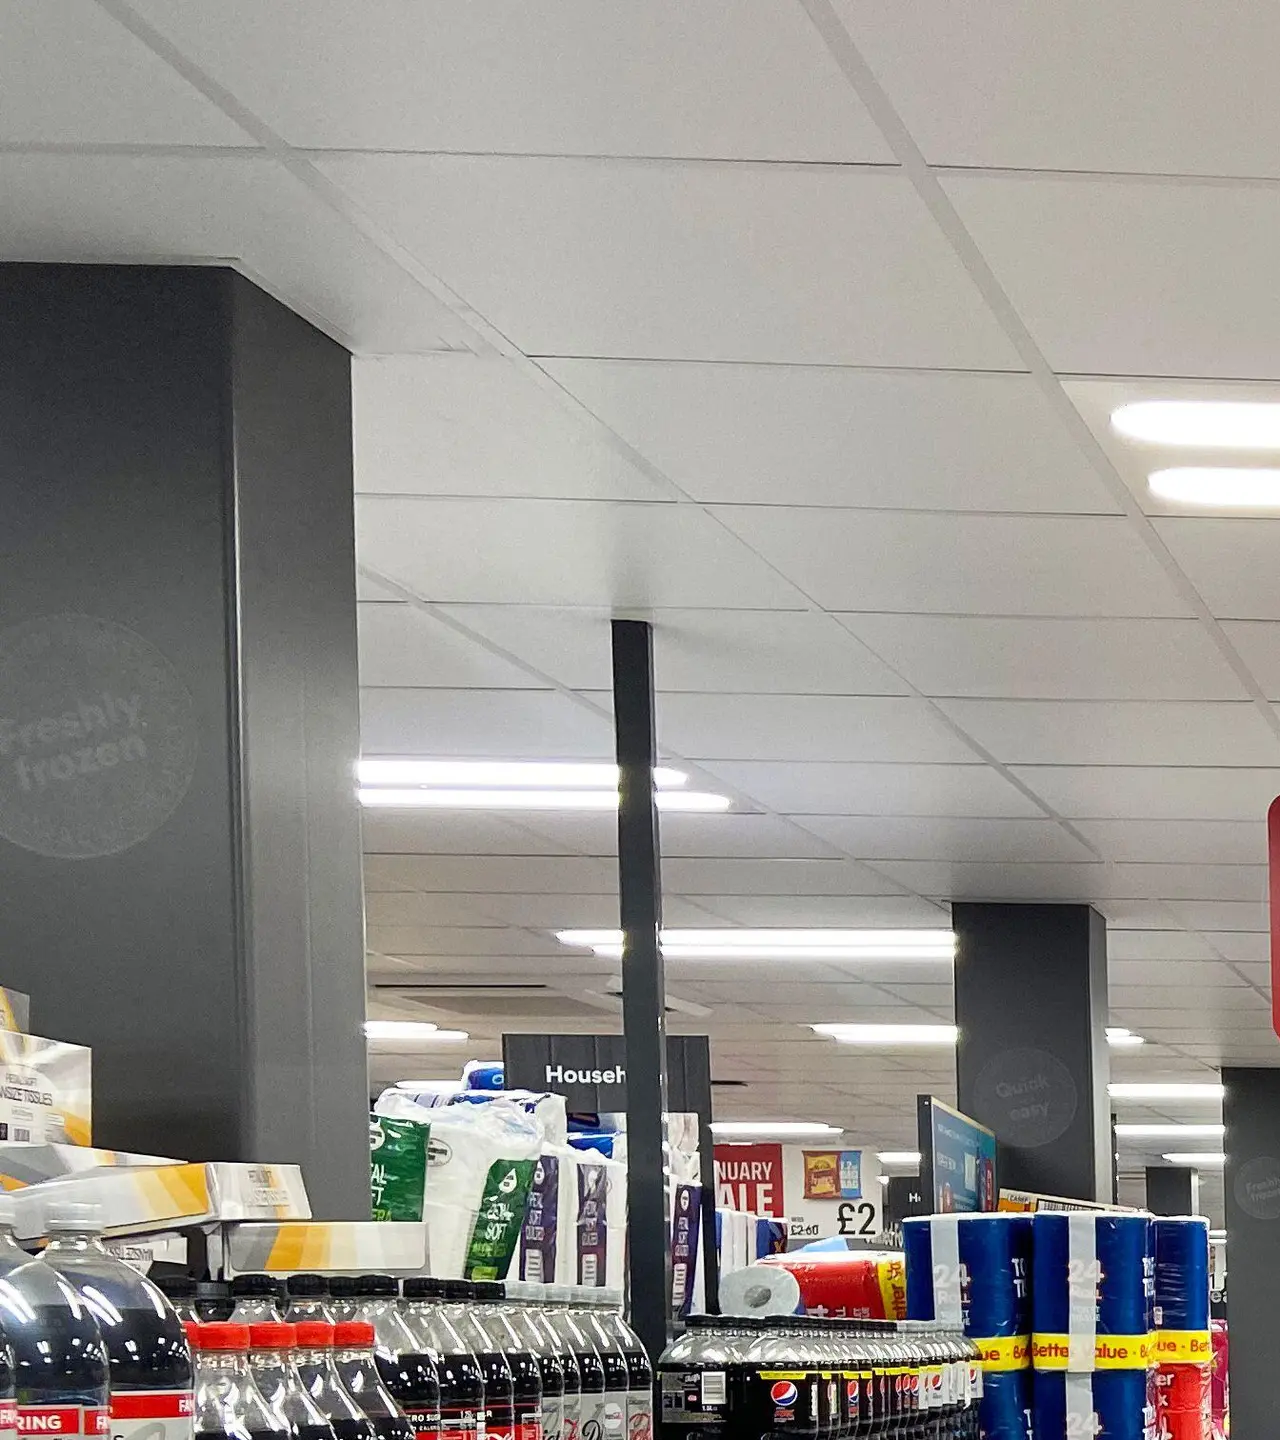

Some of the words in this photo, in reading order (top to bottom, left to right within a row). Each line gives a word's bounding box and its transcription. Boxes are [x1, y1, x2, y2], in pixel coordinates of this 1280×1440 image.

[545, 1064, 626, 1085] Househ
[714, 1161, 772, 1182] NUARY
[713, 1183, 775, 1217] ALE
[837, 1202, 876, 1235] £2
[1068, 1259, 1106, 1283] 24
[1067, 1411, 1102, 1436] 24
